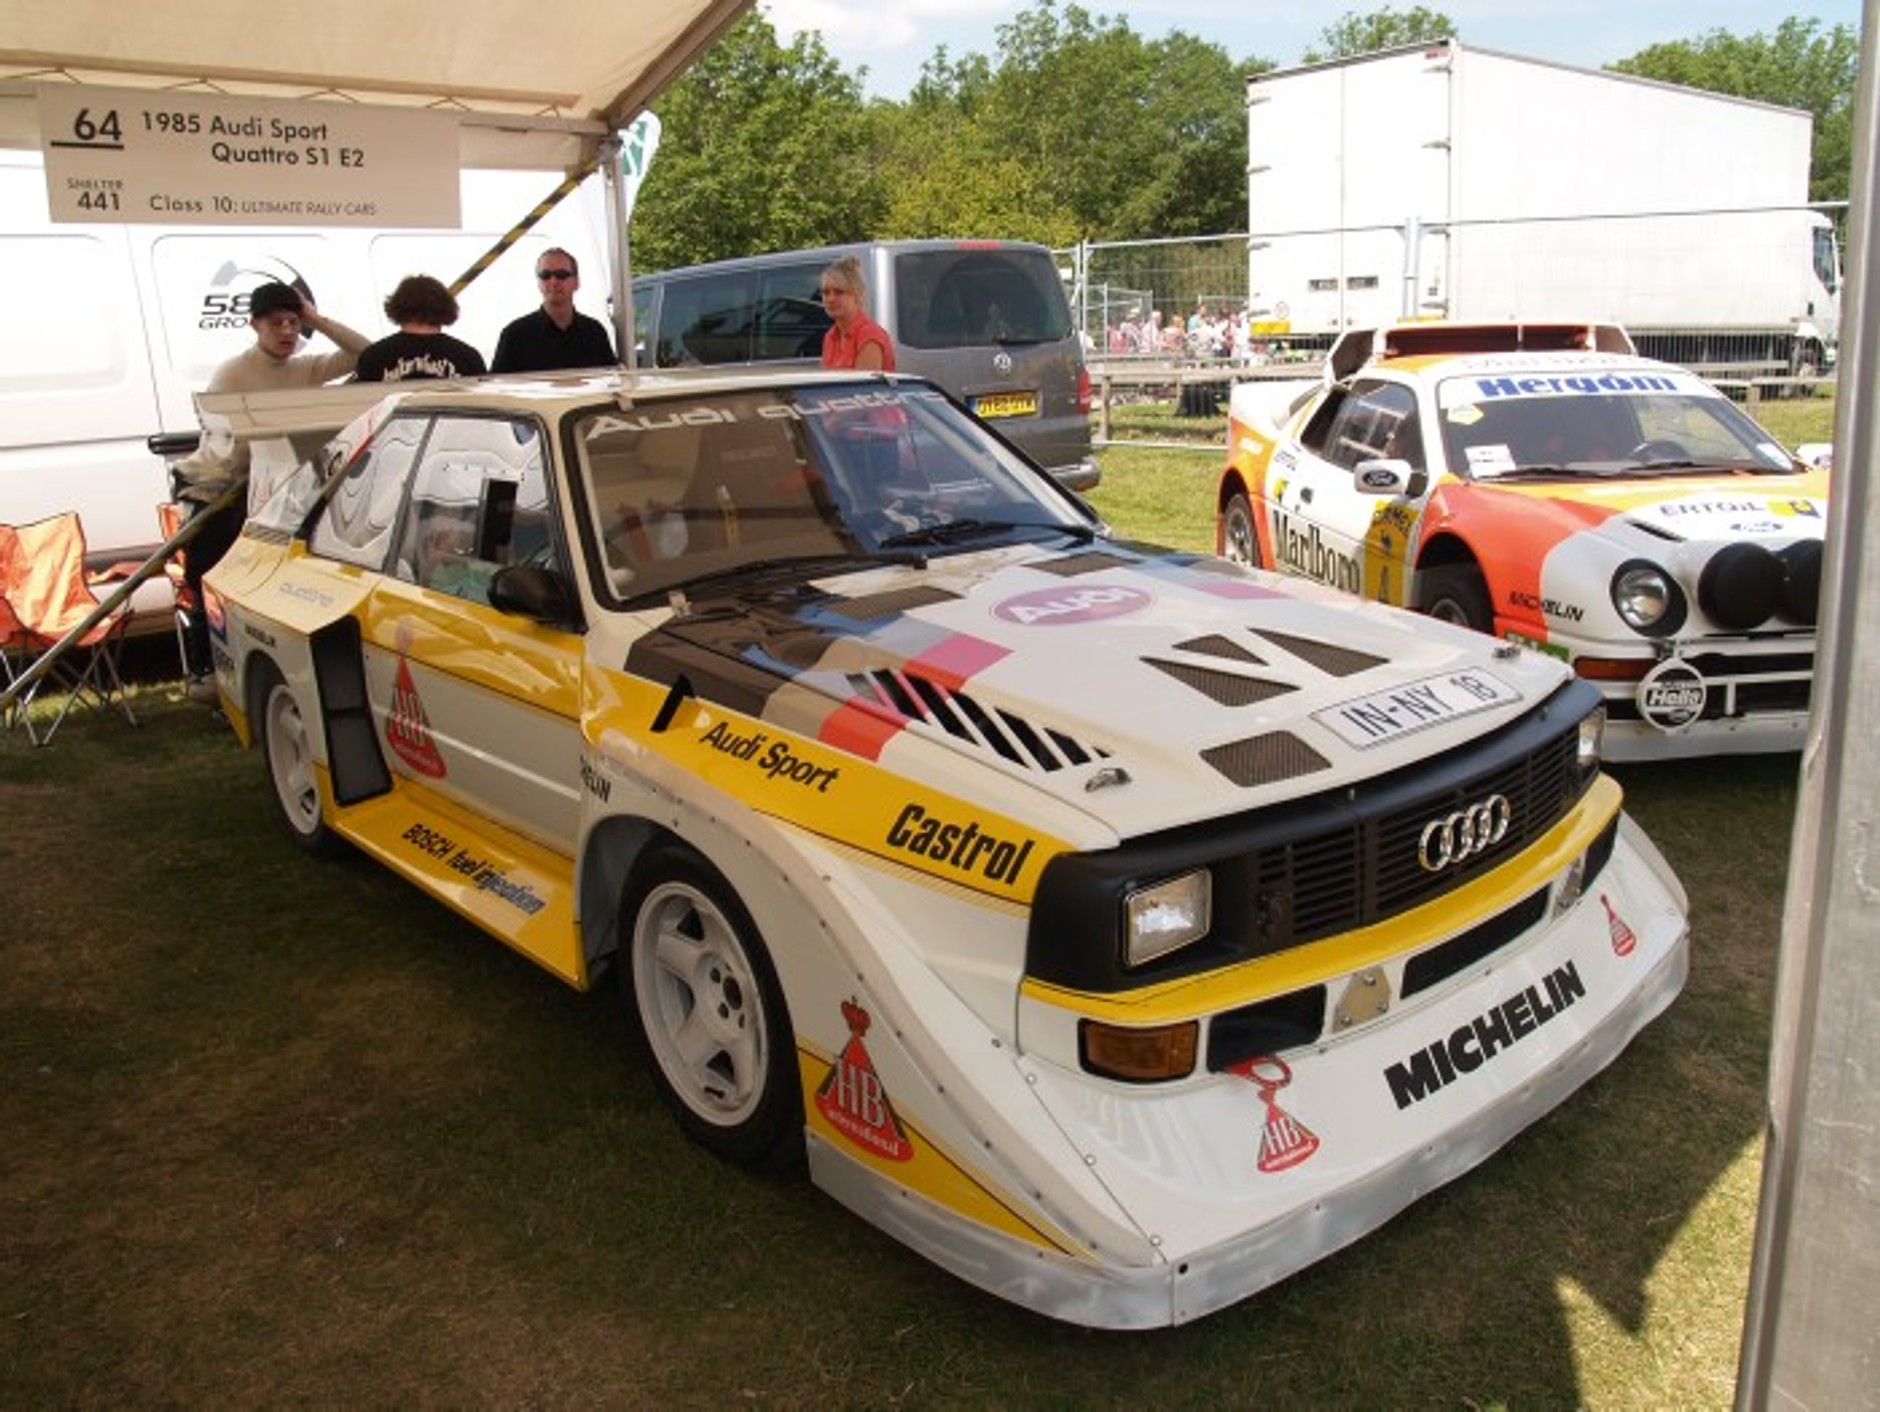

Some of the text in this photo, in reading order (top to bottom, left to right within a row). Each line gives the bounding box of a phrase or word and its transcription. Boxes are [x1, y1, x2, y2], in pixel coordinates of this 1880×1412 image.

[73, 108, 122, 141] 64
[142, 110, 327, 143] 1985 Audi Sport
[211, 142, 364, 167] Quattro S1 E2
[67, 178, 123, 190] SHELTER
[77, 191, 120, 211] 441
[150, 194, 377, 216] Class 10: ULTIMATE RALLY CARS
[584, 407, 737, 440] Audi
[1272, 510, 1361, 595] Marlboro
[1007, 588, 1140, 624] Audi
[700, 721, 841, 793] Audi Sport
[885, 803, 1035, 886] Castrol
[1383, 958, 1586, 1111] MICHELIN
[837, 1056, 886, 1128] HB
